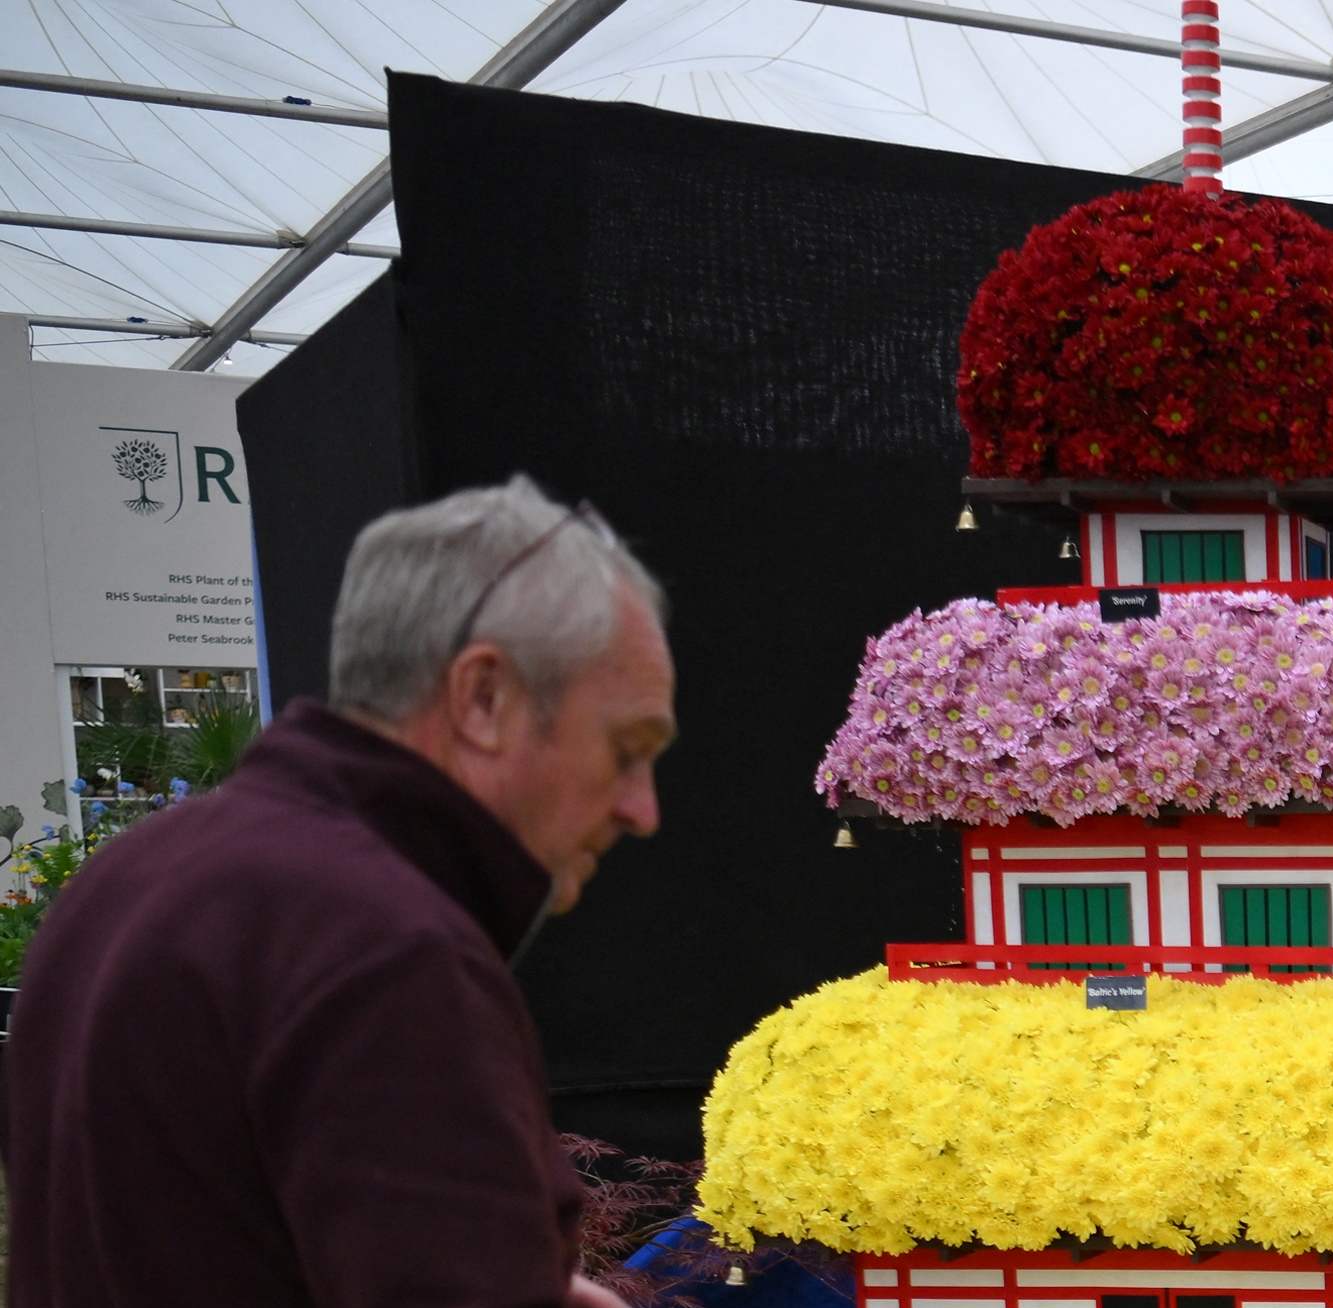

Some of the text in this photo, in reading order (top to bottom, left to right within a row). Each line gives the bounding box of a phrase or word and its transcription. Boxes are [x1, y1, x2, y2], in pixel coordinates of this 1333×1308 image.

[193, 445, 242, 504] R
[168, 574, 193, 584] RHS
[196, 575, 224, 586] Plant
[227, 576, 239, 586] of
[105, 591, 255, 606] RHS Sustainable Garden P
[176, 614, 200, 624] RHS
[203, 615, 241, 626] Master
[168, 633, 254, 646] Peter Seabrook
